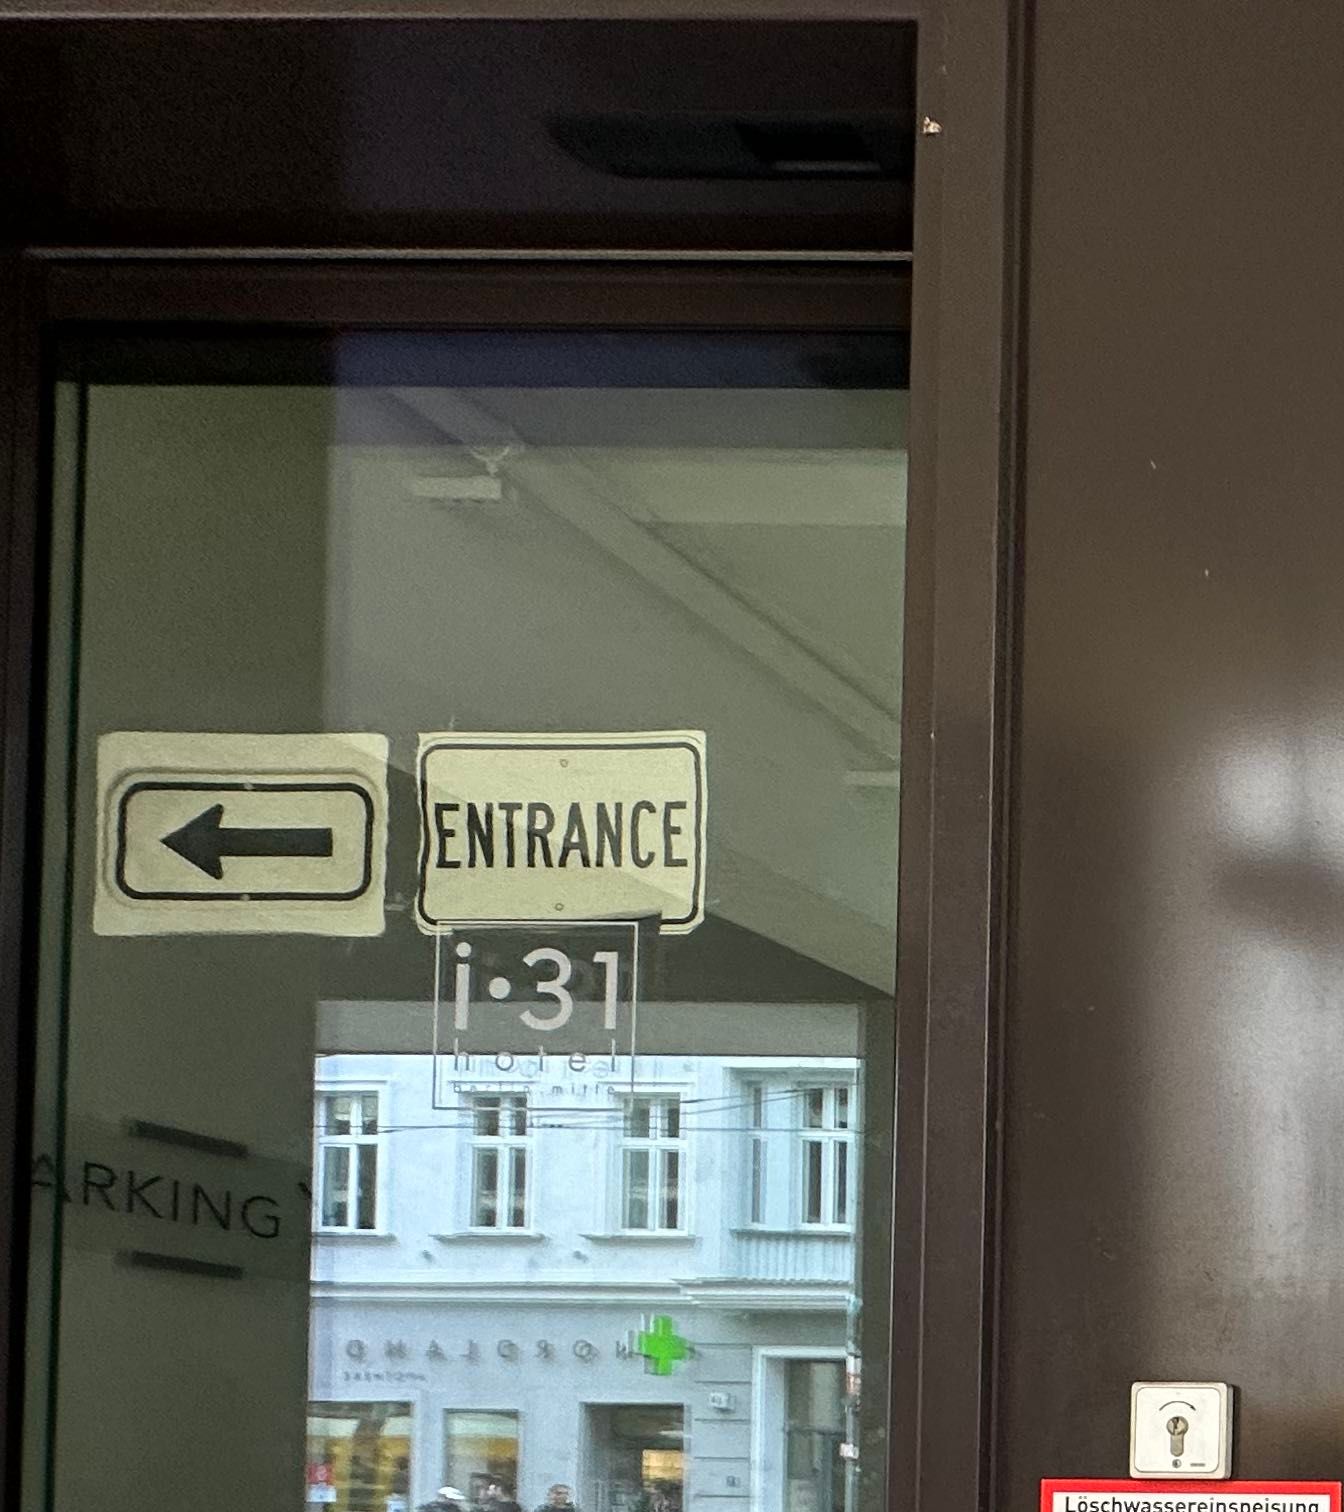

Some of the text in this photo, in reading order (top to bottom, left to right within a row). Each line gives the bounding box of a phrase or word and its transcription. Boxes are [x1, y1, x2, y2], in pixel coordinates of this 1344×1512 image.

[434, 800, 688, 869] ENTRANCE
[453, 1037, 617, 1072] hotel
[31, 1153, 283, 1239] ARKING
